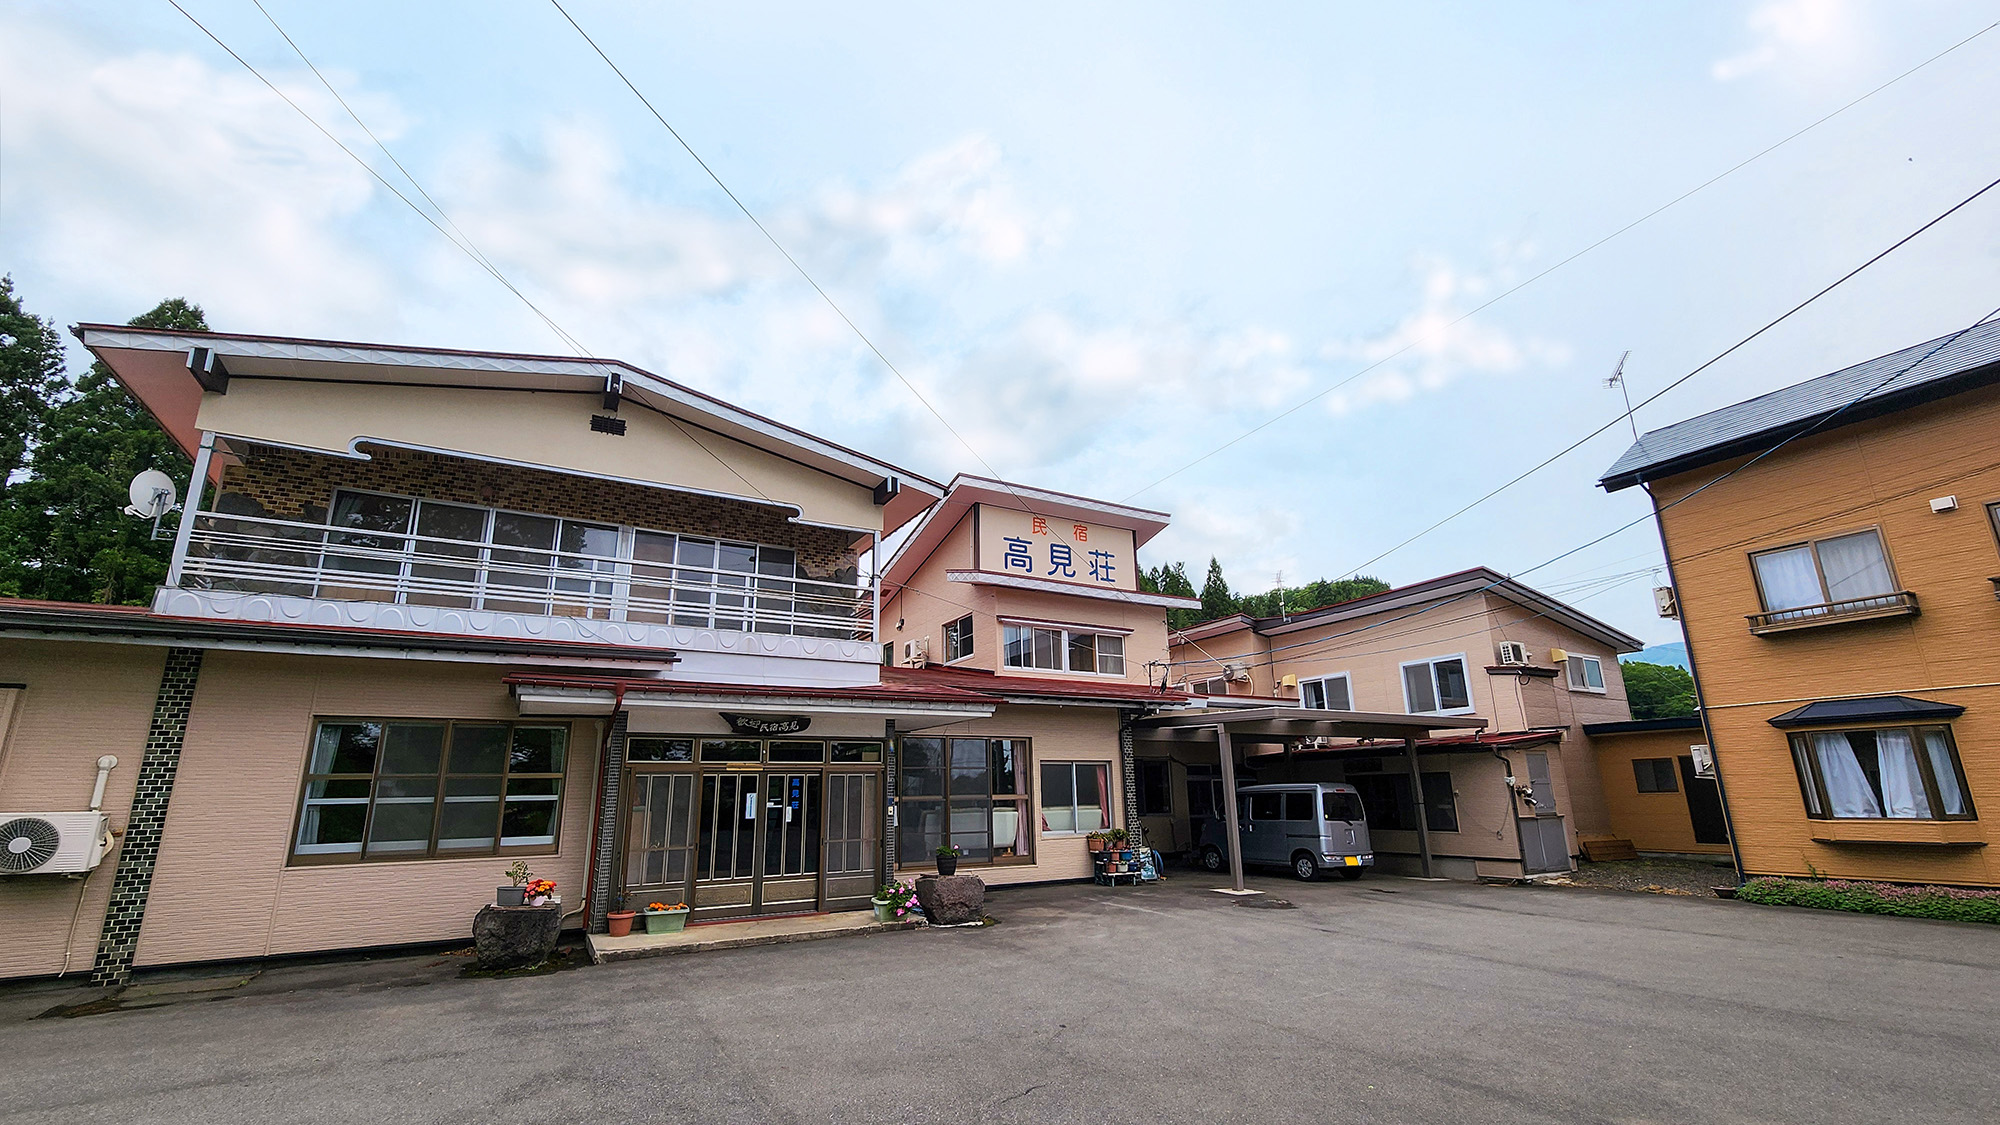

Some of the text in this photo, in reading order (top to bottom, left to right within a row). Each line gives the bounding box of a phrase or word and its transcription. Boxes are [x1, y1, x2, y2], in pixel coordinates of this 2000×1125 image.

[1032, 517, 1088, 542] 民宿
[1003, 536, 1116, 583] 高見荘
[791, 779, 800, 809] 高見荘
